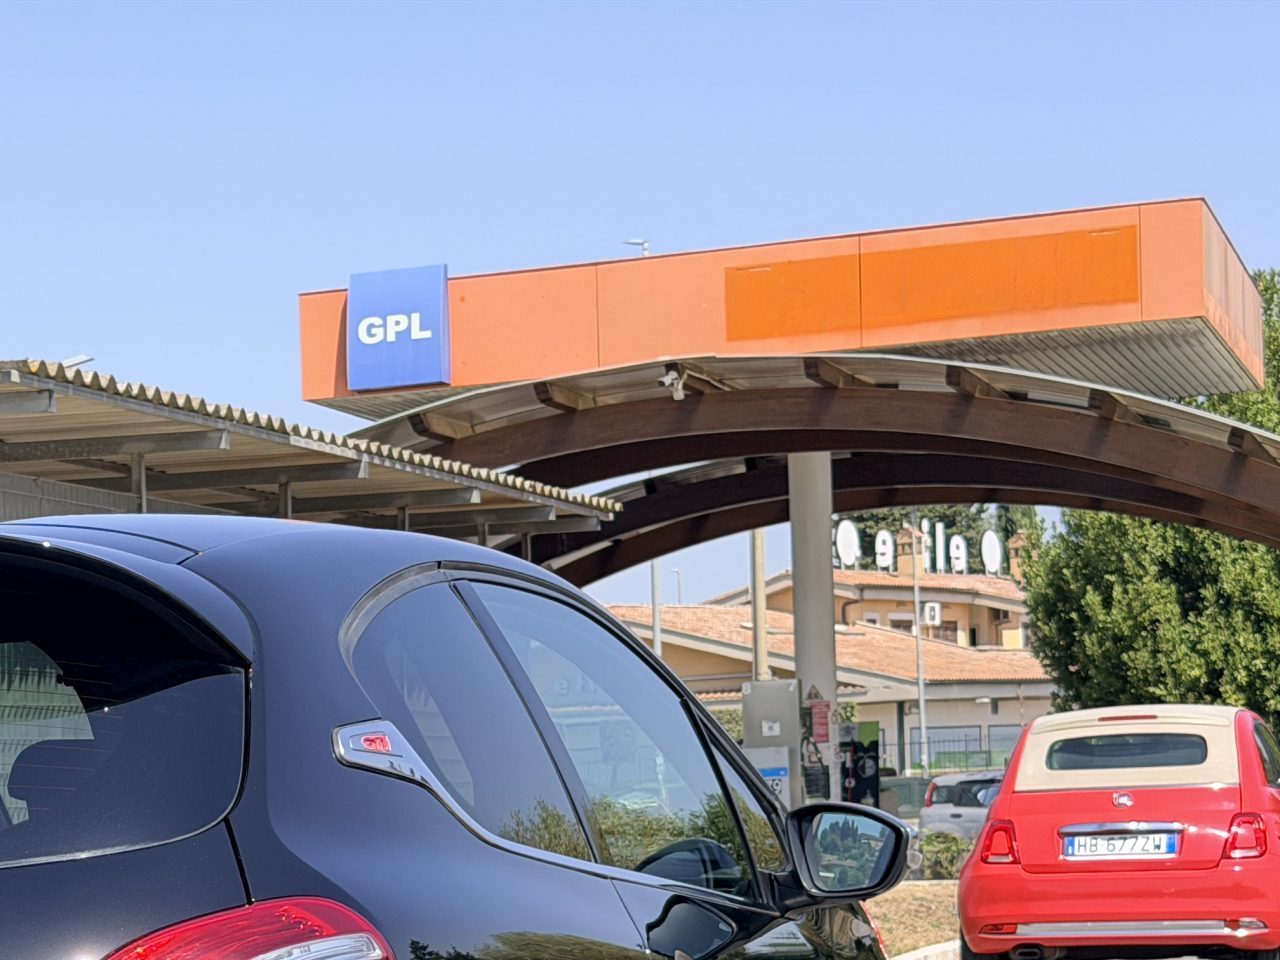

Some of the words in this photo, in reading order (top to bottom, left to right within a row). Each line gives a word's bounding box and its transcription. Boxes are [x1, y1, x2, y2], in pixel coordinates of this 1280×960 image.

[357, 312, 433, 345] GPL
[1077, 836, 1098, 853] HB
[1106, 835, 1162, 853] 677ZW
